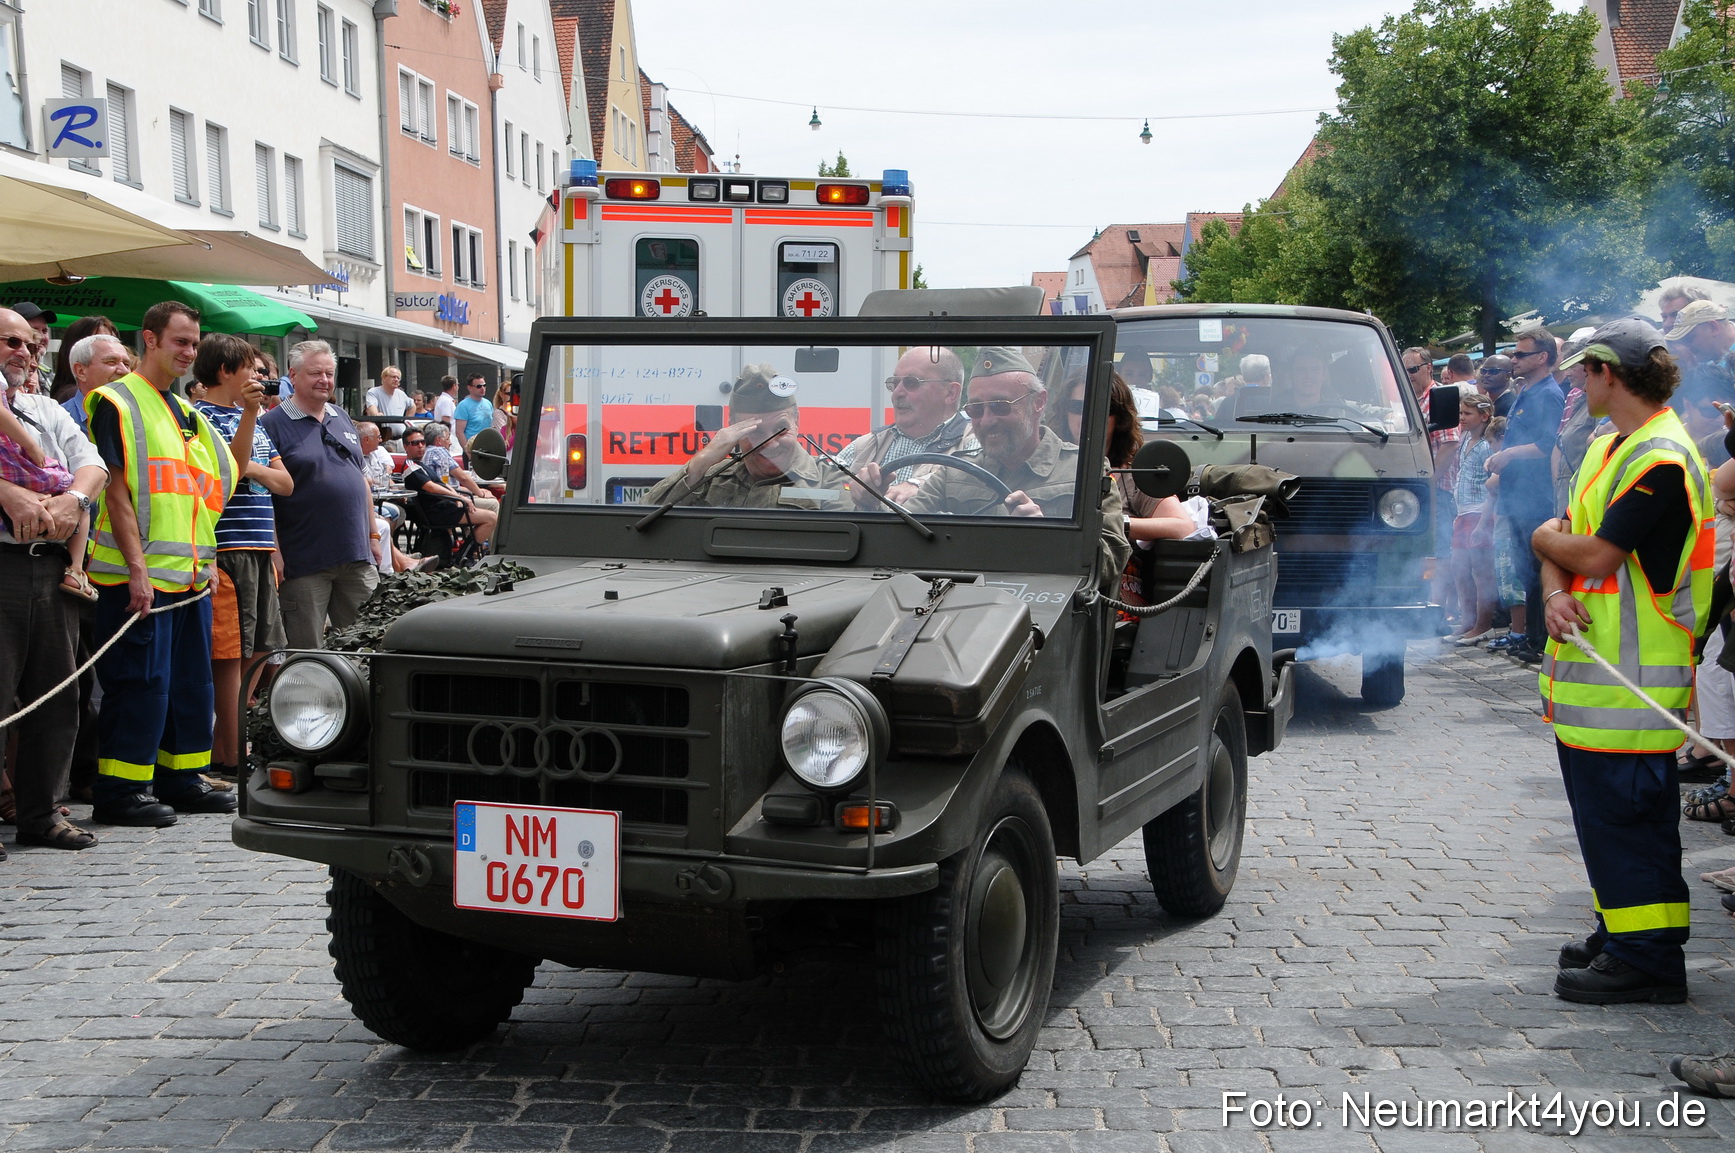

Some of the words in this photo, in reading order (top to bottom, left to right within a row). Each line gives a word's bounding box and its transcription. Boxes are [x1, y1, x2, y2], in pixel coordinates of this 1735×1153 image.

[802, 250, 811, 258] 71
[818, 250, 829, 258] 22
[4, 286, 106, 295] Neumarkter
[646, 279, 689, 299] BAYERISCHES
[787, 282, 830, 303] BAYERISCHES
[623, 488, 642, 502] NM
[1020, 592, 1066, 604] 663
[462, 833, 471, 846] D
[505, 813, 557, 859] NM
[486, 861, 585, 910] 0670
